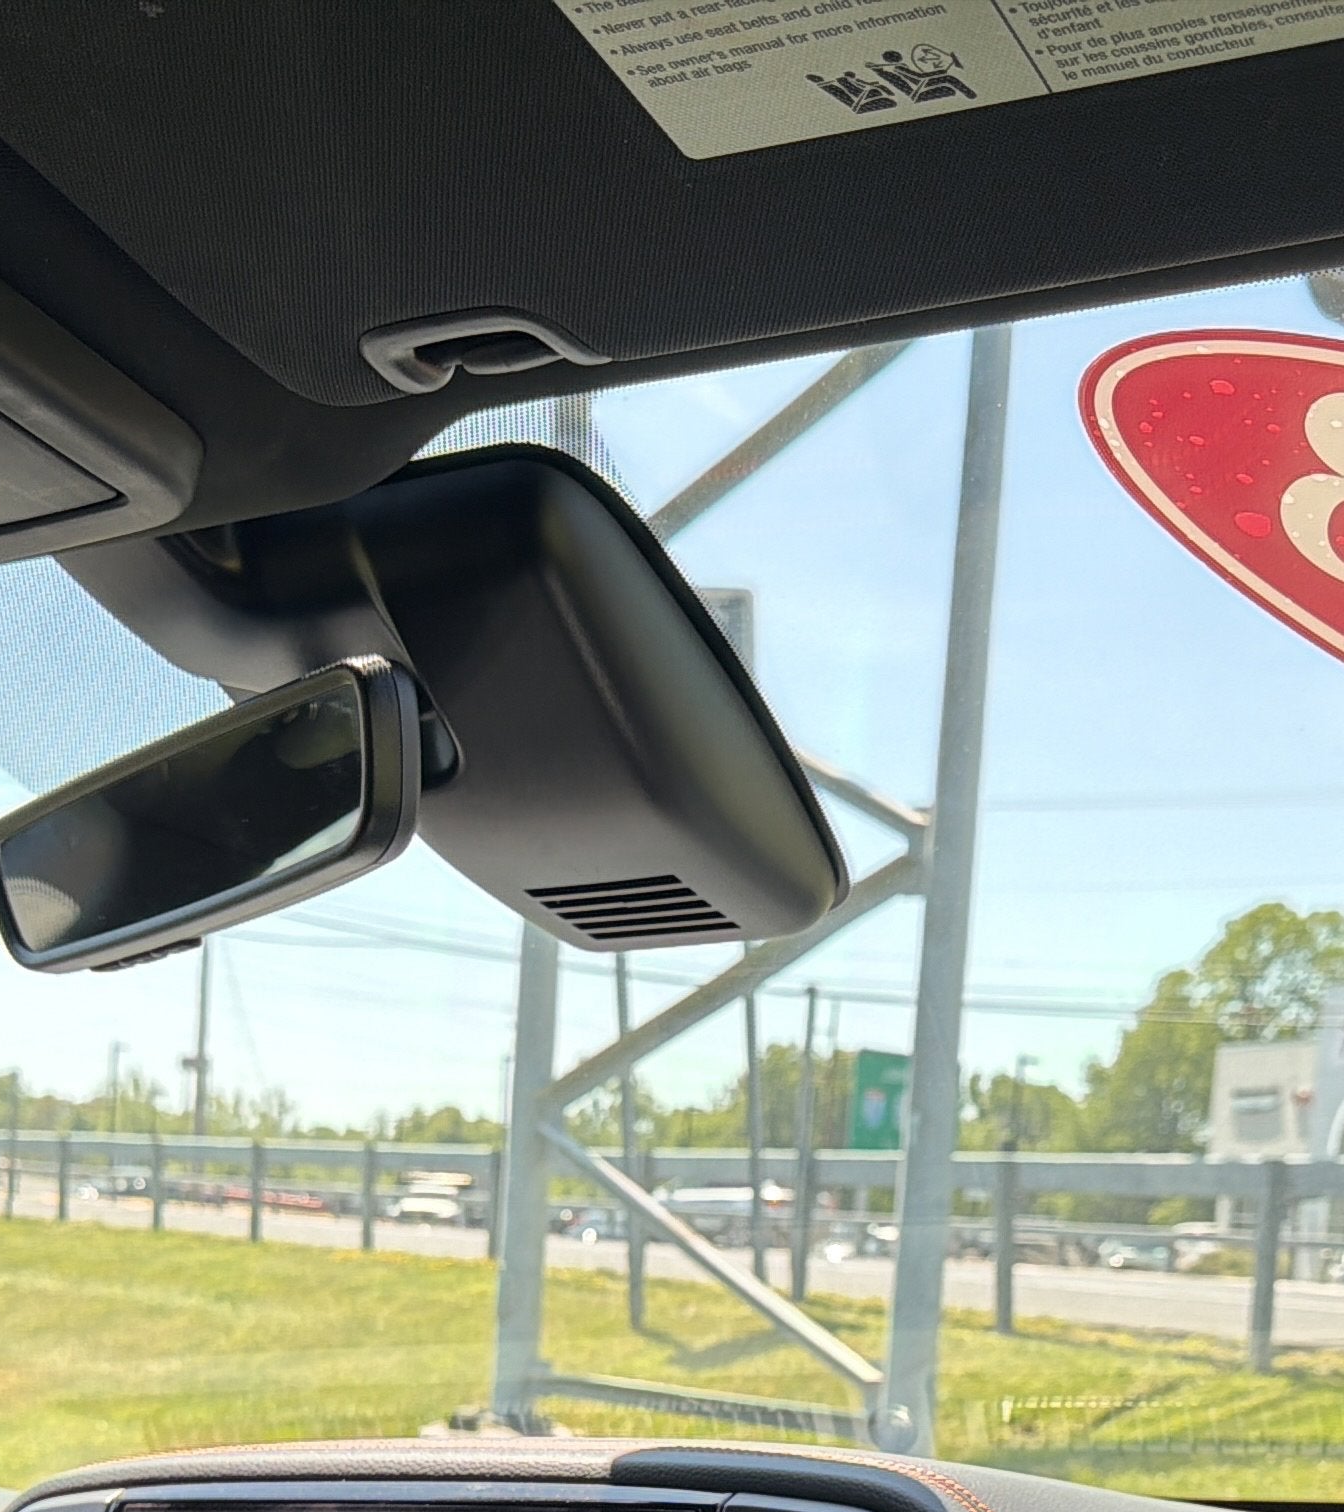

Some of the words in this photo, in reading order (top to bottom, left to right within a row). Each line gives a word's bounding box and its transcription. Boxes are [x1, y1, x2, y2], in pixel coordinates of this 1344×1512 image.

[601, 18, 645, 35] Never
[649, 12, 675, 27] put
[677, 9, 690, 19] a
[1096, 1, 1114, 13] et
[620, 37, 673, 56] Always
[676, 31, 703, 46] use
[705, 22, 741, 38] seat
[739, 15, 779, 30] belts
[781, 6, 812, 22] and
[635, 64, 666, 76] See
[667, 50, 727, 71] owner's
[728, 38, 785, 60] manual
[786, 33, 809, 45] for
[812, 24, 853, 40] more
[854, 4, 947, 31] information
[1038, 18, 1103, 39] d'enfant
[1046, 42, 1083, 57] Pour
[1087, 35, 1108, 49] de
[1110, 28, 1145, 46] plus
[1148, 17, 1207, 36] amples
[1055, 57, 1080, 69] sur
[1085, 49, 1108, 63] les
[1110, 36, 1180, 59] coussins
[1062, 70, 1078, 81] le
[1081, 57, 1139, 78] manuel
[1144, 53, 1164, 66] du
[1167, 36, 1256, 62] conducteur
[648, 71, 690, 88] about
[692, 66, 710, 79] air
[713, 59, 752, 75] bags
